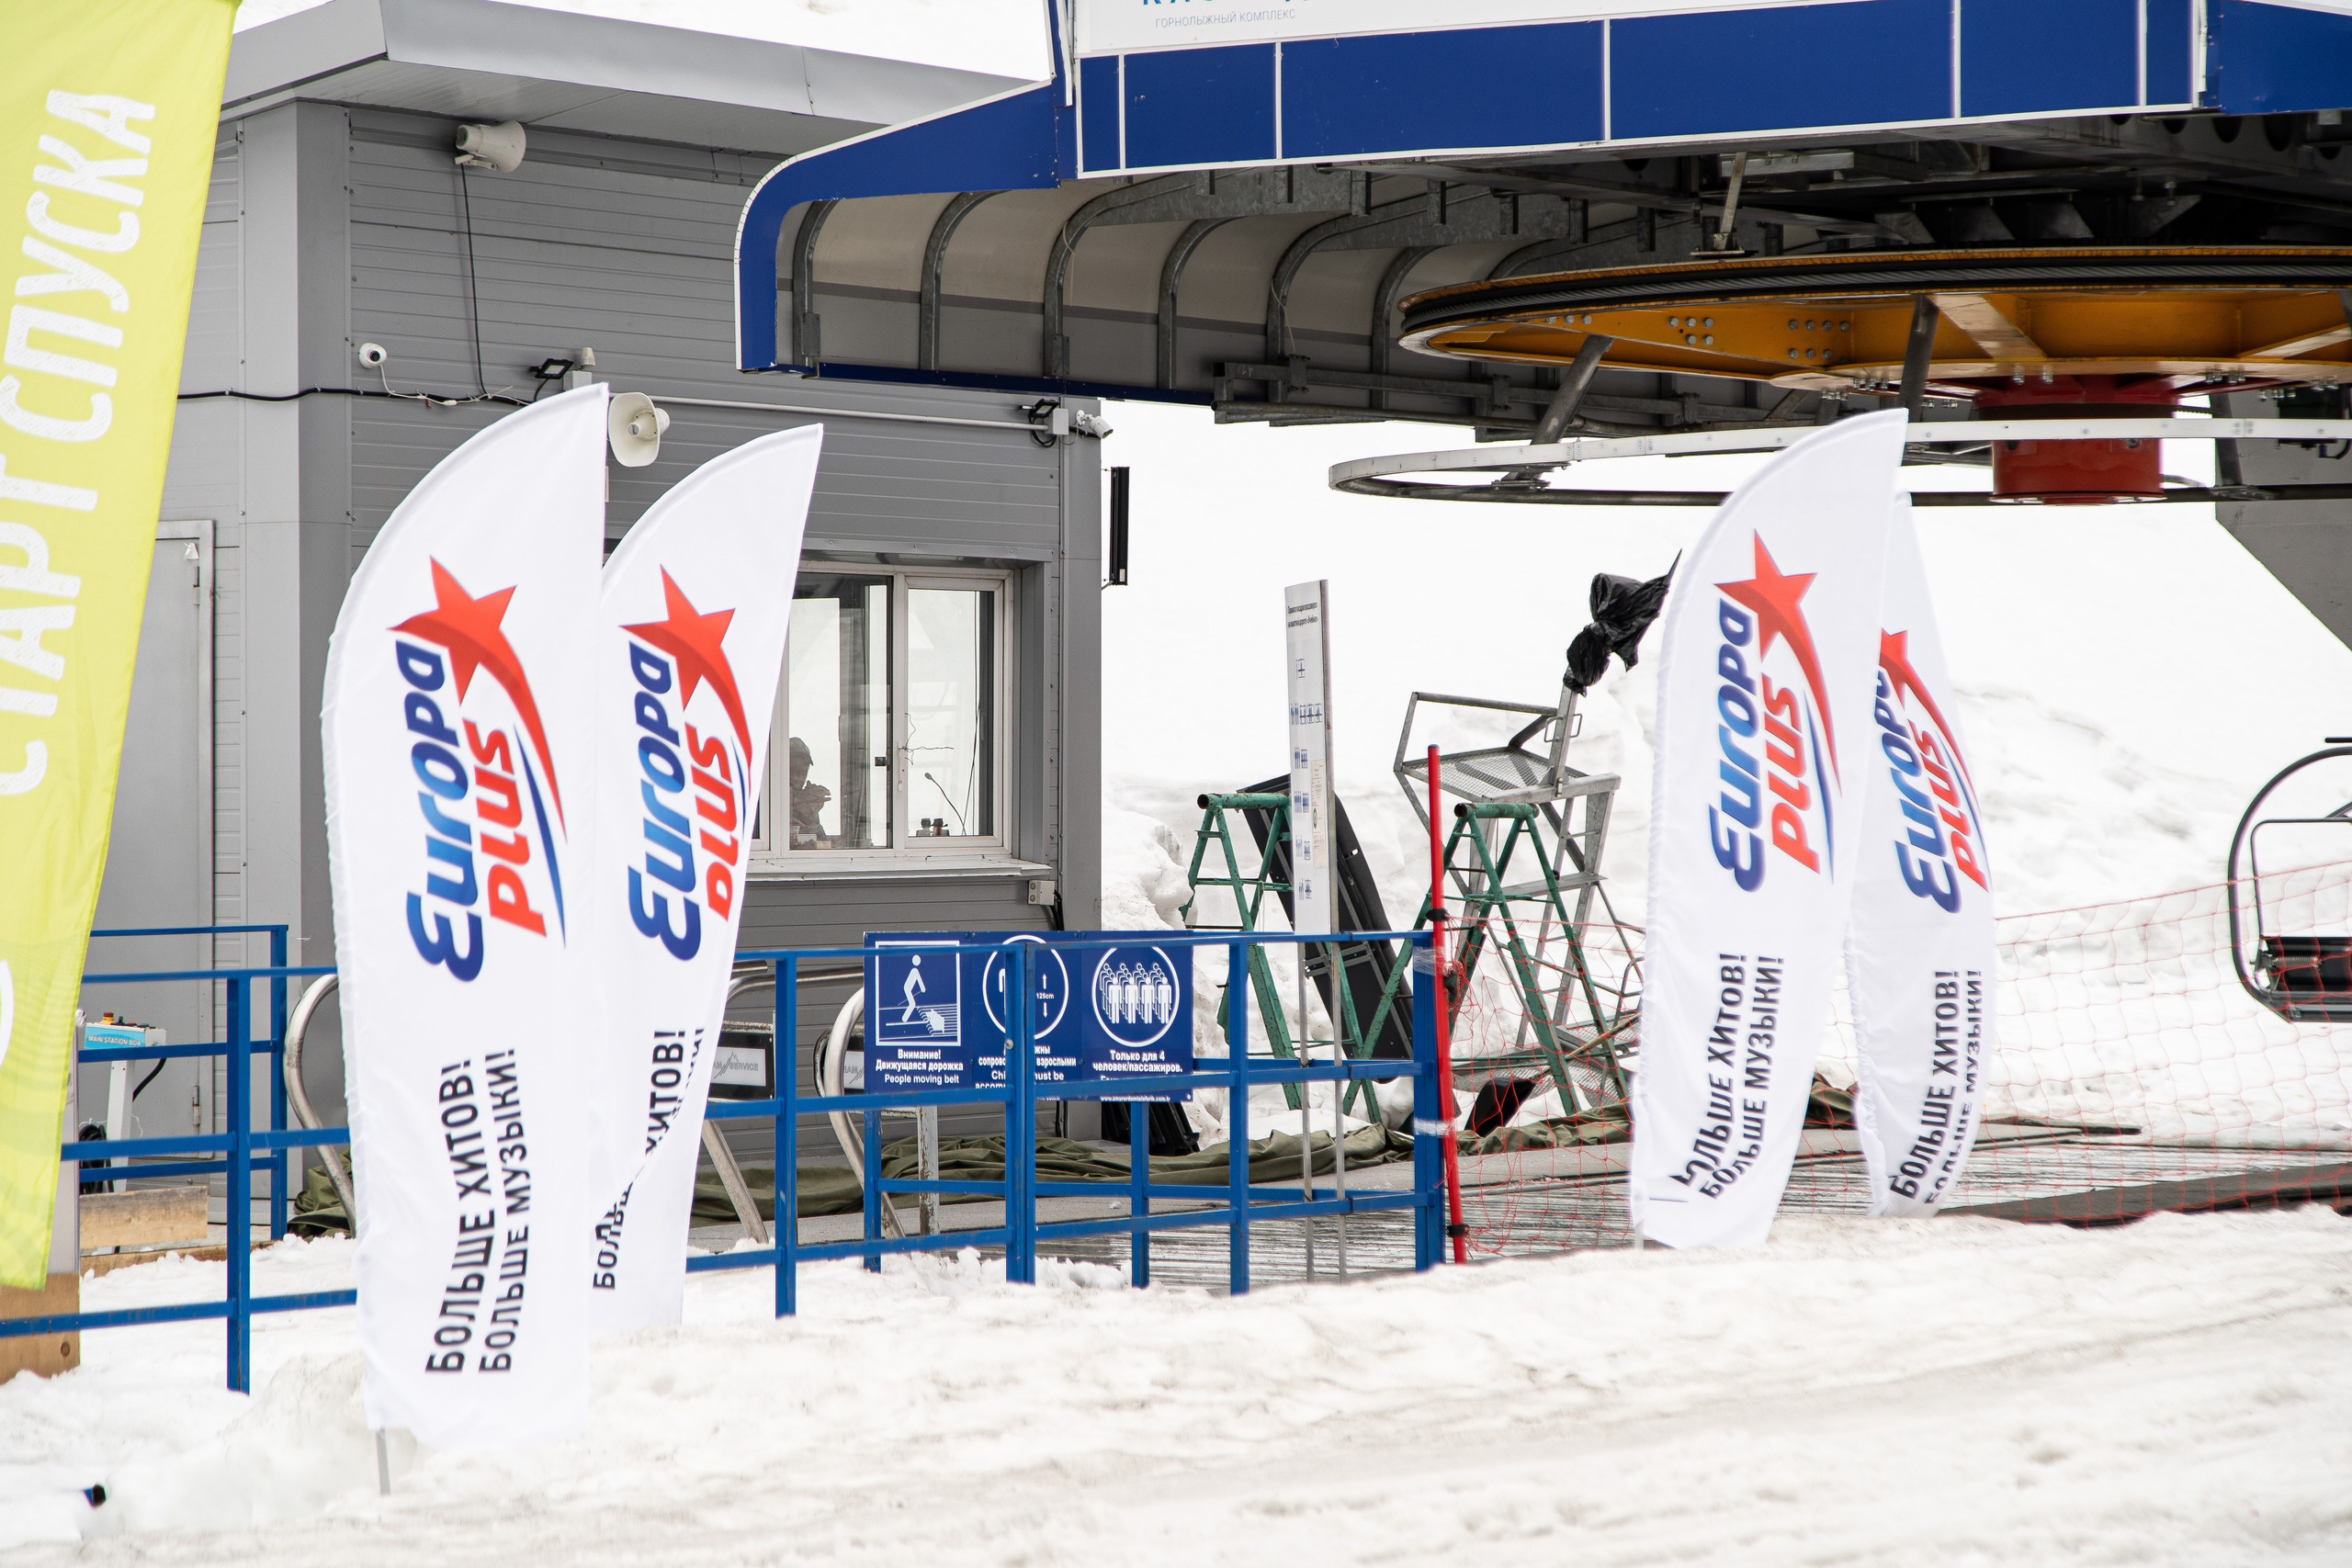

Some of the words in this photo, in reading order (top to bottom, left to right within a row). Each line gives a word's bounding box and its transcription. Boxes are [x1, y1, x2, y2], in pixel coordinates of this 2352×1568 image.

[1155, 11, 1237, 28] ГОРНОЛЫЖНЫЙ
[1239, 8, 1296, 22] КОМПЛЕКС
[0, 89, 156, 443] СПУСКА
[461, 716, 548, 938] plus
[1761, 672, 1820, 874] plus
[1906, 718, 1990, 894] plus
[88, 1035, 103, 1043] MAIN
[104, 1036, 128, 1045] STATION
[129, 1039, 142, 1047] BOX
[876, 1059, 927, 1072] Движущаяся
[928, 1062, 964, 1073] дорожка
[898, 1048, 942, 1060] Внимание!
[1054, 1070, 1065, 1081] be
[1092, 1061, 1183, 1075] человек/пассажиров.
[1110, 1049, 1140, 1061] Только
[1142, 1053, 1158, 1063] для
[1159, 1049, 1166, 1061] 4
[1707, 953, 1747, 1069] ХИТОВ!
[1966, 970, 1984, 1093] МУЗЫКИ!
[438, 1059, 492, 1197] ХИТОВ!
[484, 1048, 532, 1216] МУЗЫКИ!
[885, 1074, 911, 1085] People
[913, 1075, 943, 1086] moving
[944, 1073, 960, 1084] belt
[1699, 1098, 1768, 1200] БОЛЬШЕ
[1744, 955, 1785, 1091] МУЗЫКИ!
[1889, 1086, 1958, 1200] БОЛЬШЕ
[1932, 970, 1961, 1077] ХИТОВ!
[424, 1209, 495, 1374] БОЛЬШЕ
[479, 1225, 530, 1373] БОЛЬШЕ
